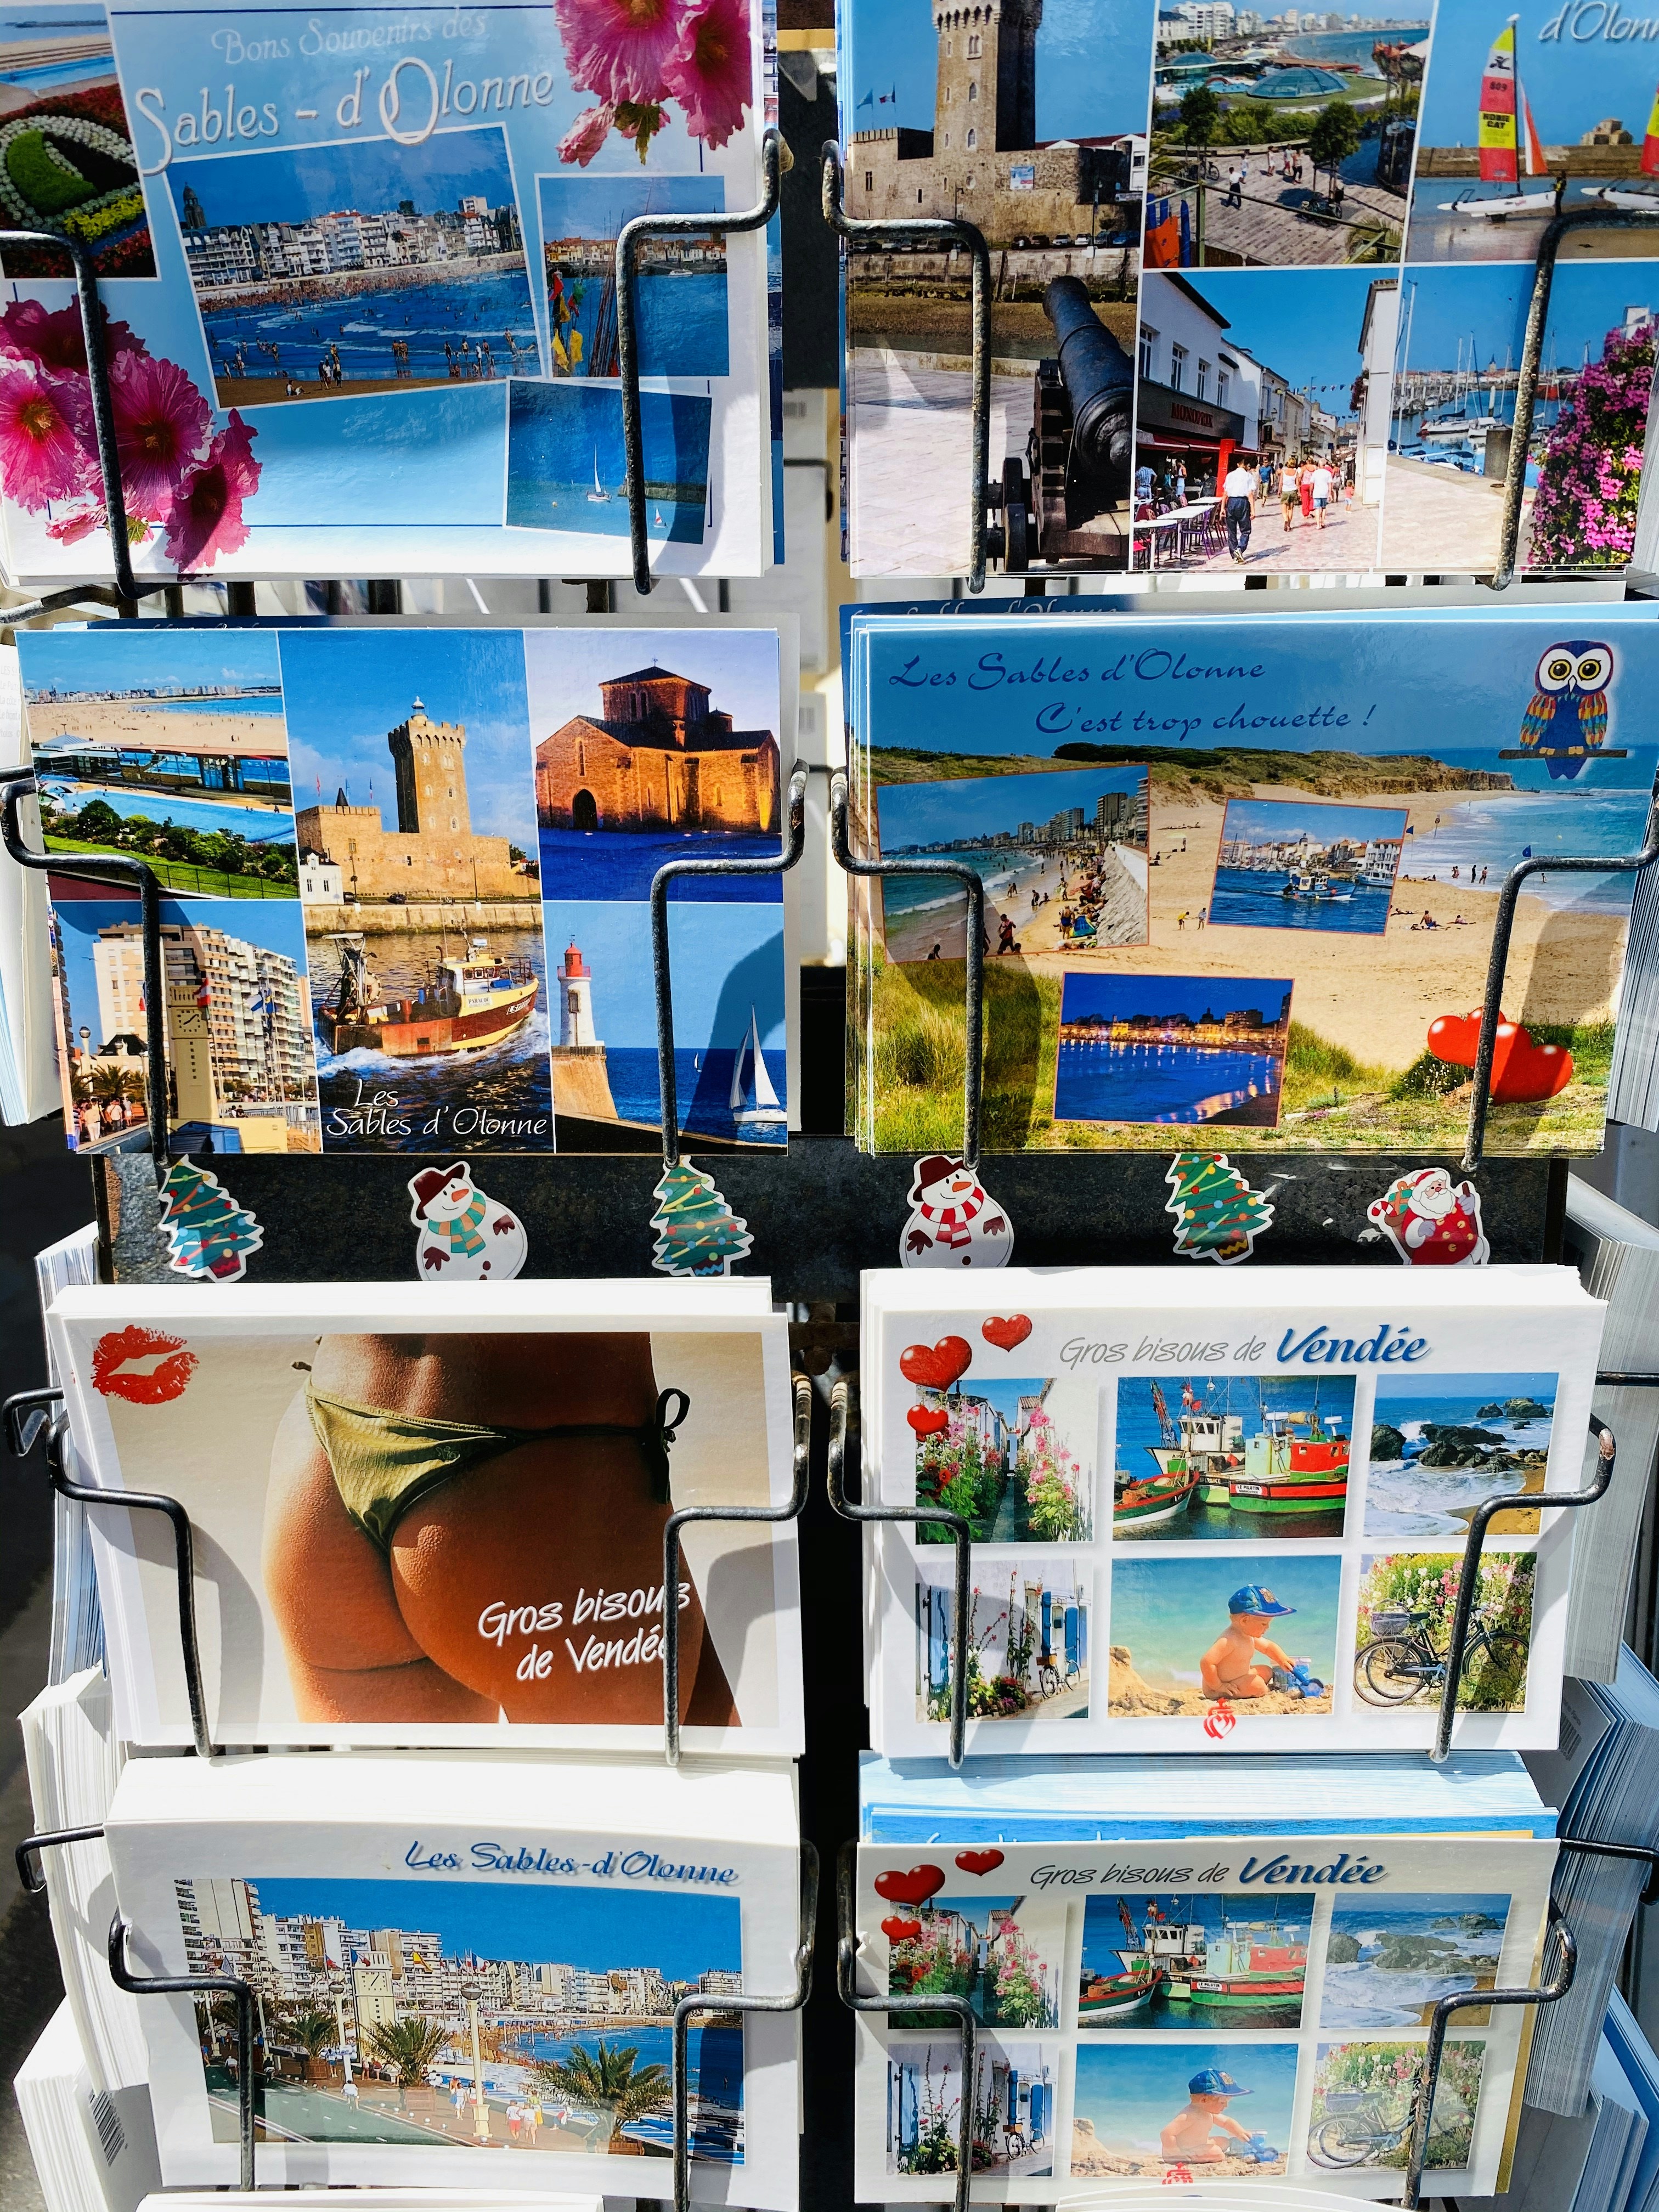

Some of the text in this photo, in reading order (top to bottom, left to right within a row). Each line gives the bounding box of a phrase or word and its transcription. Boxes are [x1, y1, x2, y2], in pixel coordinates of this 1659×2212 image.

[211, 5, 487, 65] Bons Souvenirs des
[135, 84, 280, 176] Sables
[889, 648, 1266, 690] Les Sables d'Olonne
[1035, 702, 1122, 734] C'est
[1133, 708, 1201, 741] trop
[1213, 702, 1350, 730] chouette
[355, 1077, 399, 1108] Les
[326, 1107, 548, 1136] Sables d'Olonne
[1059, 1324, 1431, 1370] Gros bisous de Vendée
[478, 1600, 563, 1646] Gros
[516, 1643, 553, 1681] de
[405, 1841, 738, 1883] Les Sables-d'Olonne
[1030, 1853, 1389, 1889] Gros bisous de Vendée
